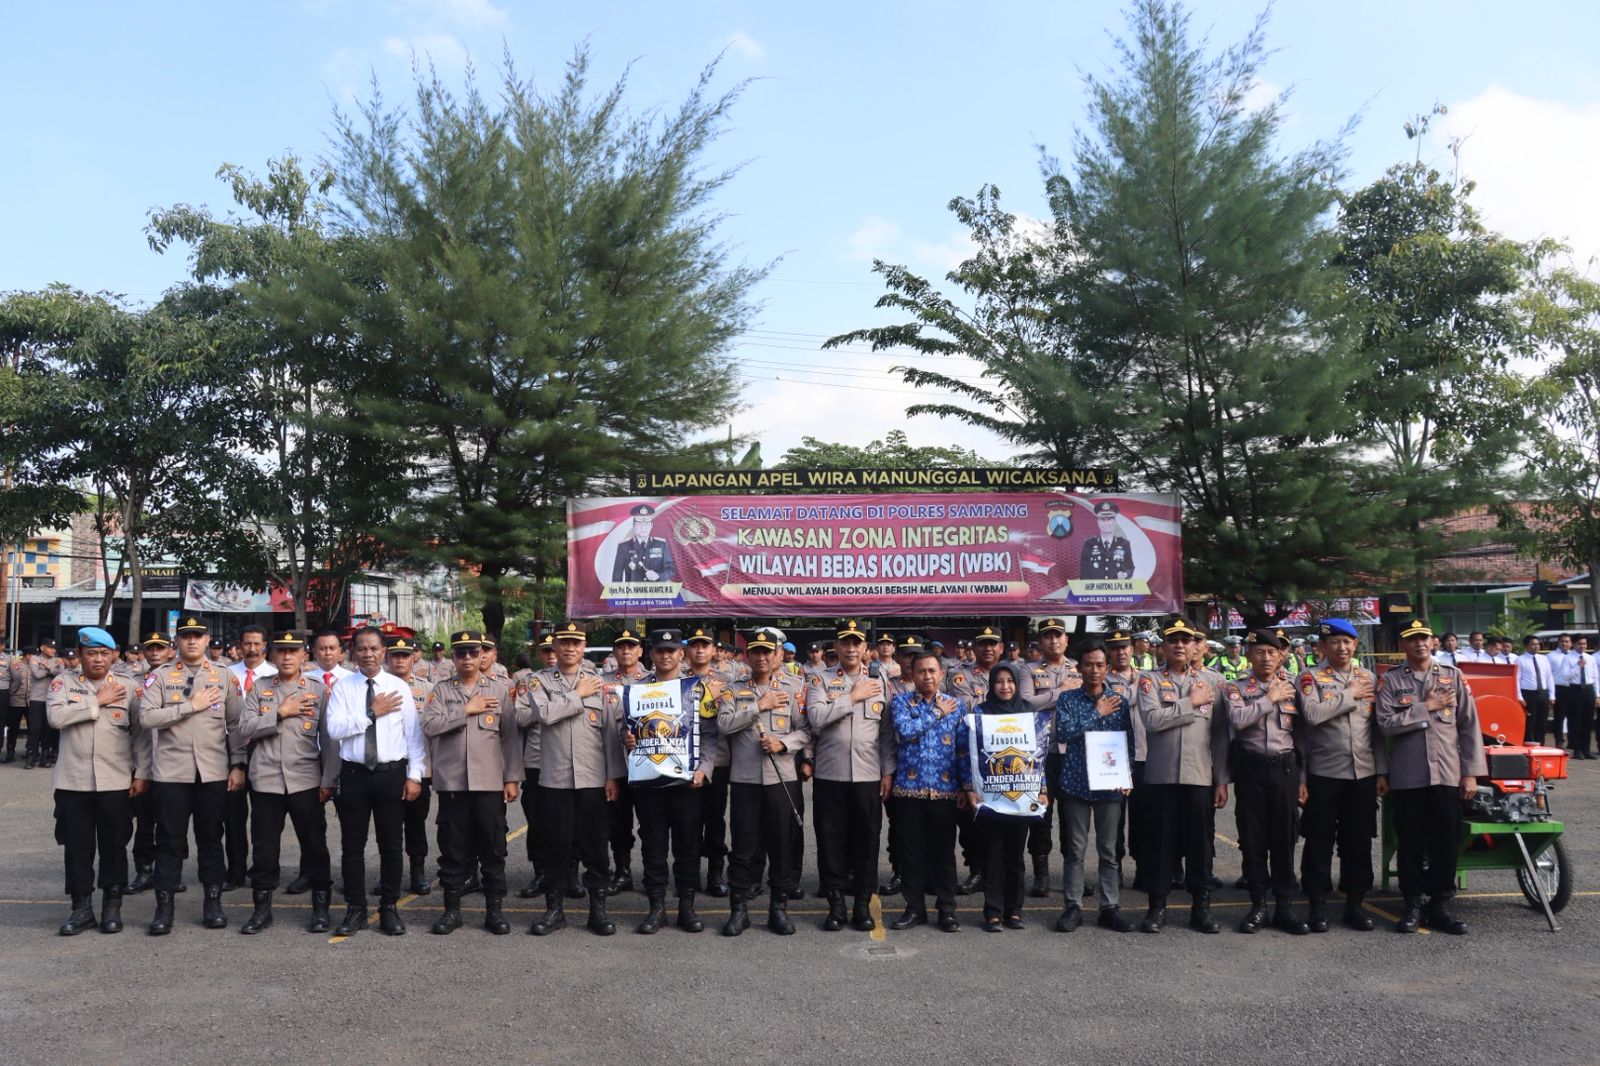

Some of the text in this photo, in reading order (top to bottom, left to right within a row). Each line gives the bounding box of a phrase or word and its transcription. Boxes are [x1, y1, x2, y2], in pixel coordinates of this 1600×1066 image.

[652, 470, 1097, 488] LAPANGAN APEL WIRA MANUNGGAL WICAKSANA
[721, 503, 1028, 520] SELAMAT DATANG DI POLRES SAMPANG
[738, 525, 1008, 549] KAWASAN ZONA INTEGRITAS
[738, 551, 1011, 578] WILAYAH BEBAS KORUPSI (WBK)
[742, 584, 1008, 595] MENUJU WILAYAH BIROKRASI BERSIH MELAYANI (WBBM)
[637, 698, 674, 711] JENDERAL
[990, 734, 1029, 745] JENDERAL
[984, 774, 1040, 784] JENDERALNYA
